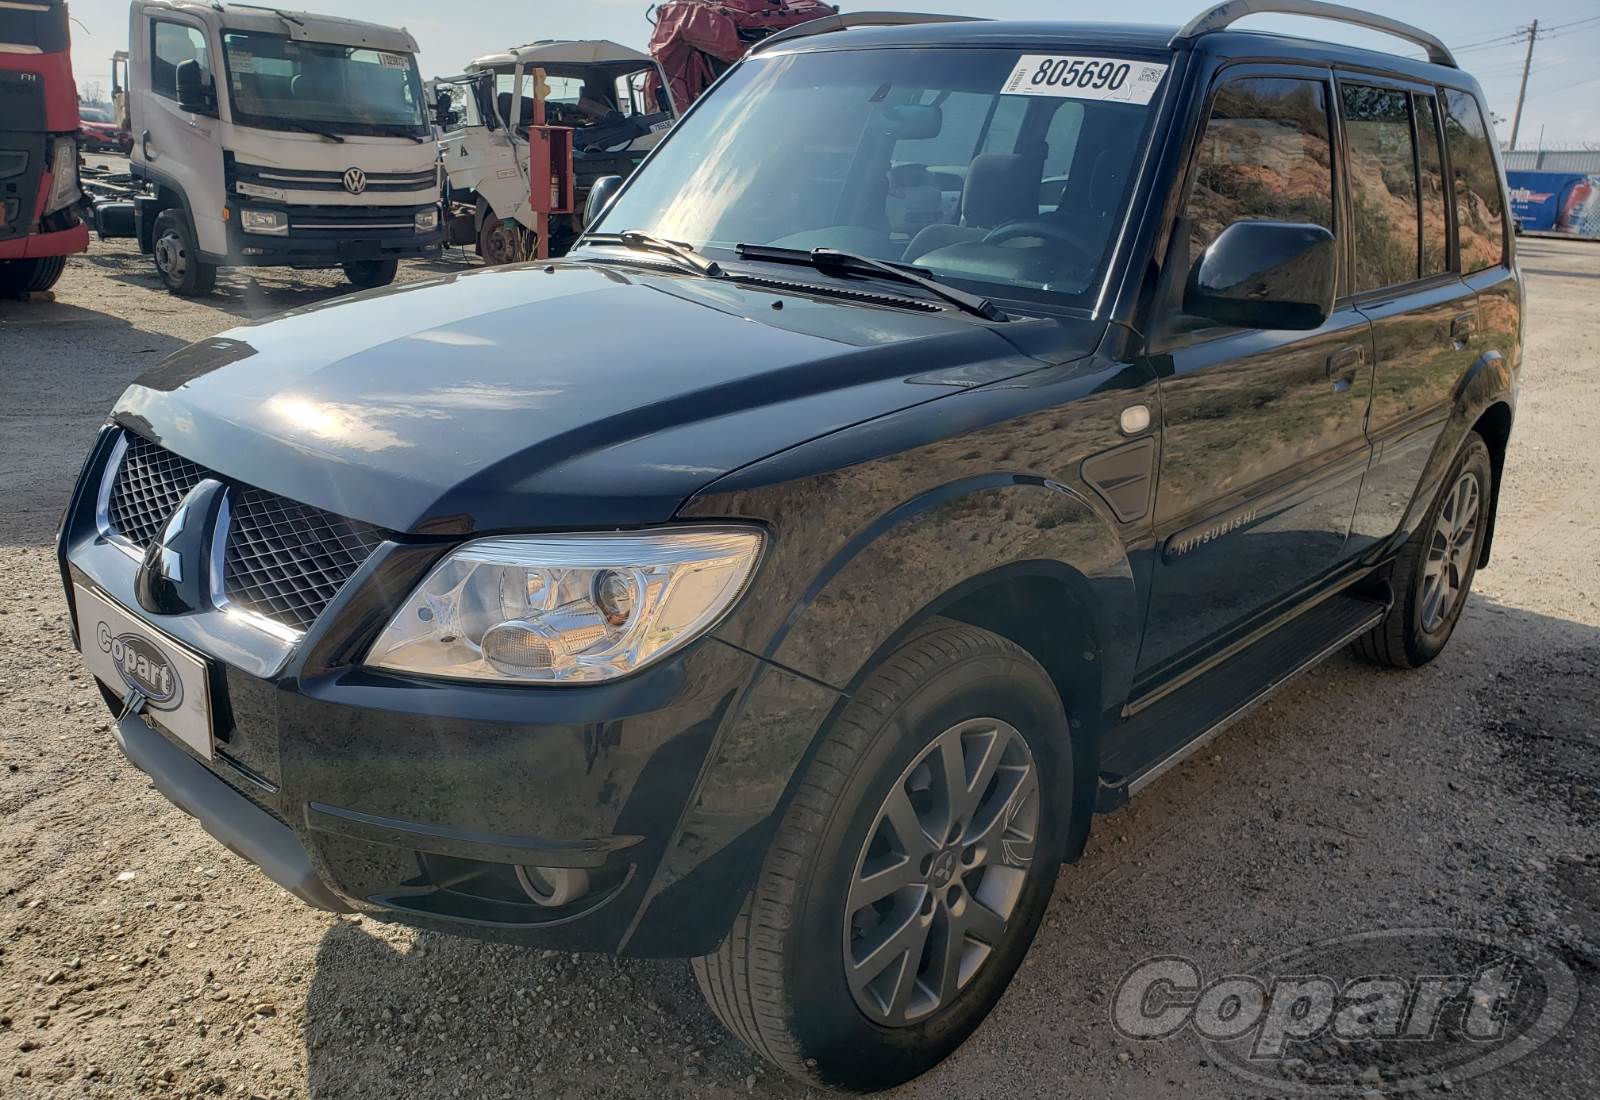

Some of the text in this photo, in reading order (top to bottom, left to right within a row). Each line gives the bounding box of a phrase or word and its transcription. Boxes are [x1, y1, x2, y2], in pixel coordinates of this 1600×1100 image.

[20, 73, 36, 81] FH
[1031, 58, 1131, 91] 805690
[1177, 510, 1257, 556] MITSUBISHI
[96, 620, 172, 695] Copart
